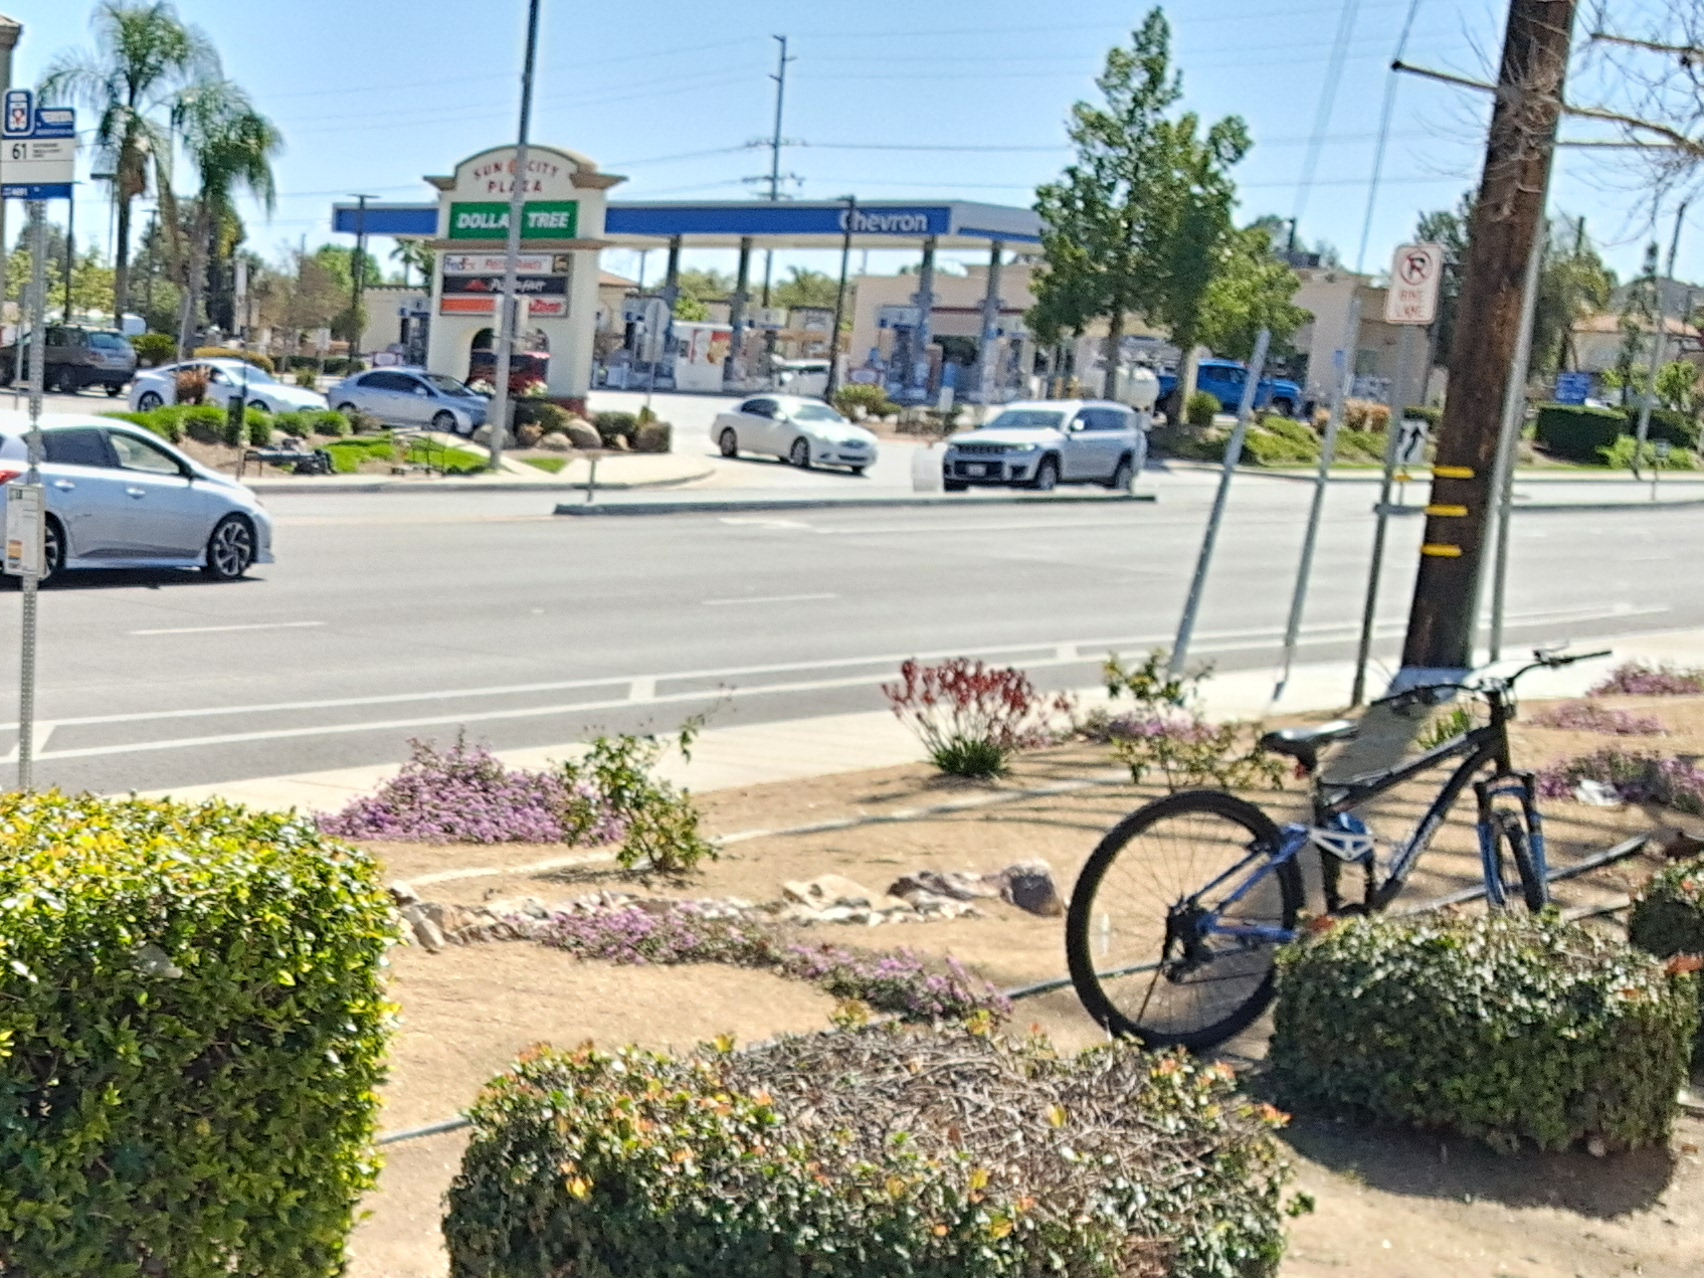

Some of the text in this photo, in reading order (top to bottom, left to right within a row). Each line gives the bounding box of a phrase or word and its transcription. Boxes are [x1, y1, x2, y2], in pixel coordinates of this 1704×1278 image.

[12, 143, 27, 160] 61
[473, 159, 560, 180] SUN CITY
[456, 211, 571, 229] DOLLA TREE
[839, 208, 928, 232] Chevron
